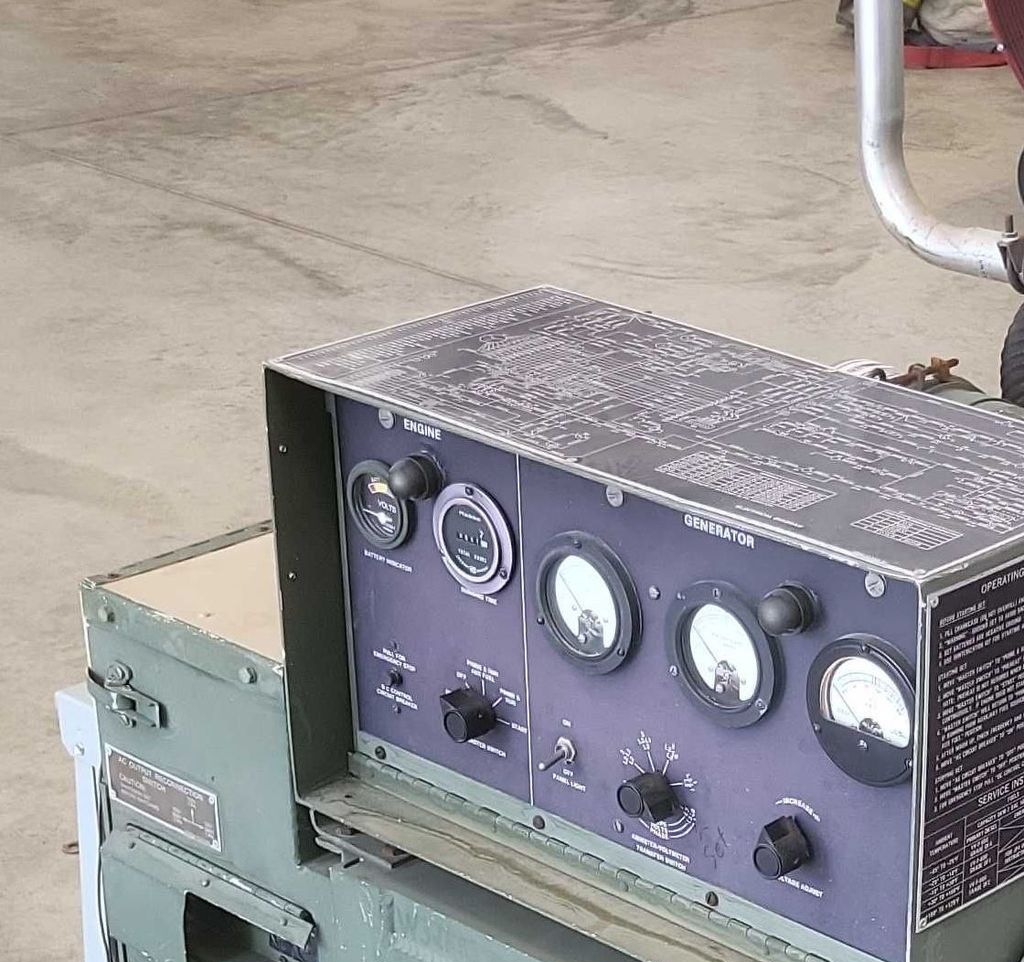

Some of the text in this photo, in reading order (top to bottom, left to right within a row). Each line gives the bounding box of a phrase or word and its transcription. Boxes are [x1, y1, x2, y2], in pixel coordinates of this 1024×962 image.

[403, 418, 442, 441] ENGINE
[377, 499, 397, 514] VOLTS
[683, 513, 755, 550] GENERATOR
[363, 549, 386, 563] BATTERY
[980, 568, 1024, 595] OPERATING
[977, 785, 1010, 807] SERVICE
